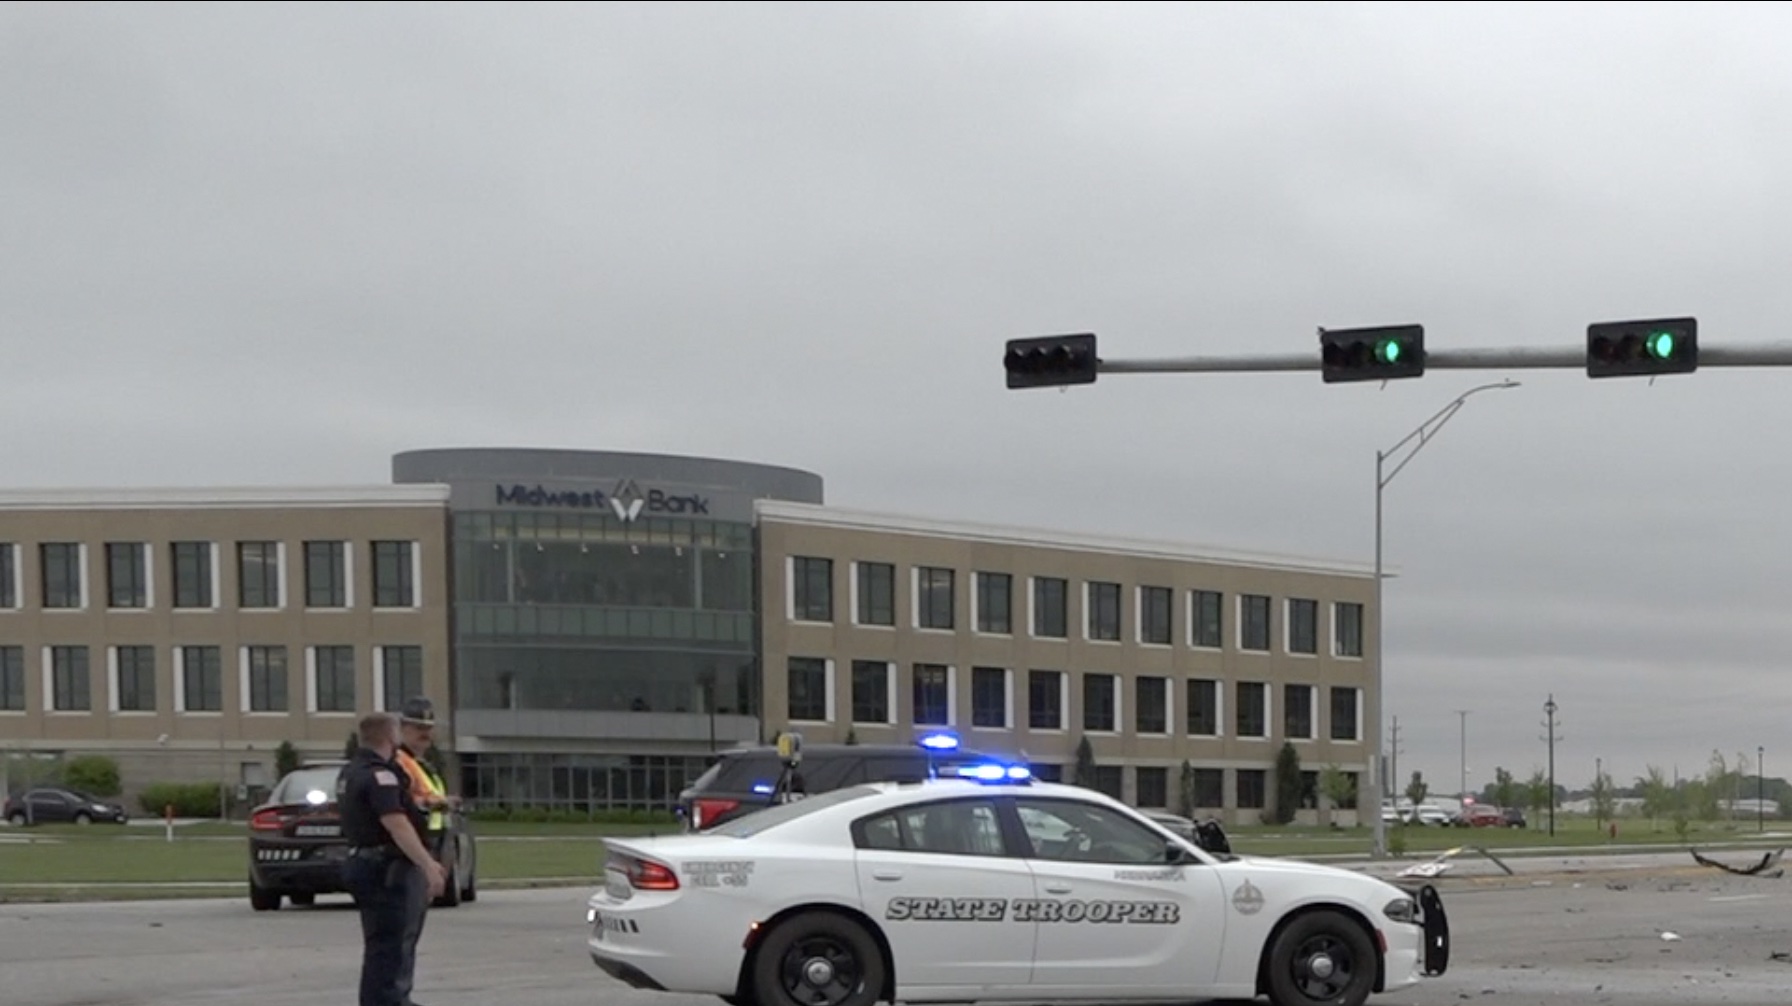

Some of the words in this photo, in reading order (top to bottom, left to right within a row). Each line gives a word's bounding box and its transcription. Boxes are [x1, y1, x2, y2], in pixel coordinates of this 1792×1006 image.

[496, 484, 605, 508] Midwest
[648, 489, 709, 514] Bank
[885, 897, 1006, 921] STATE
[1012, 899, 1180, 924] TROOPER
